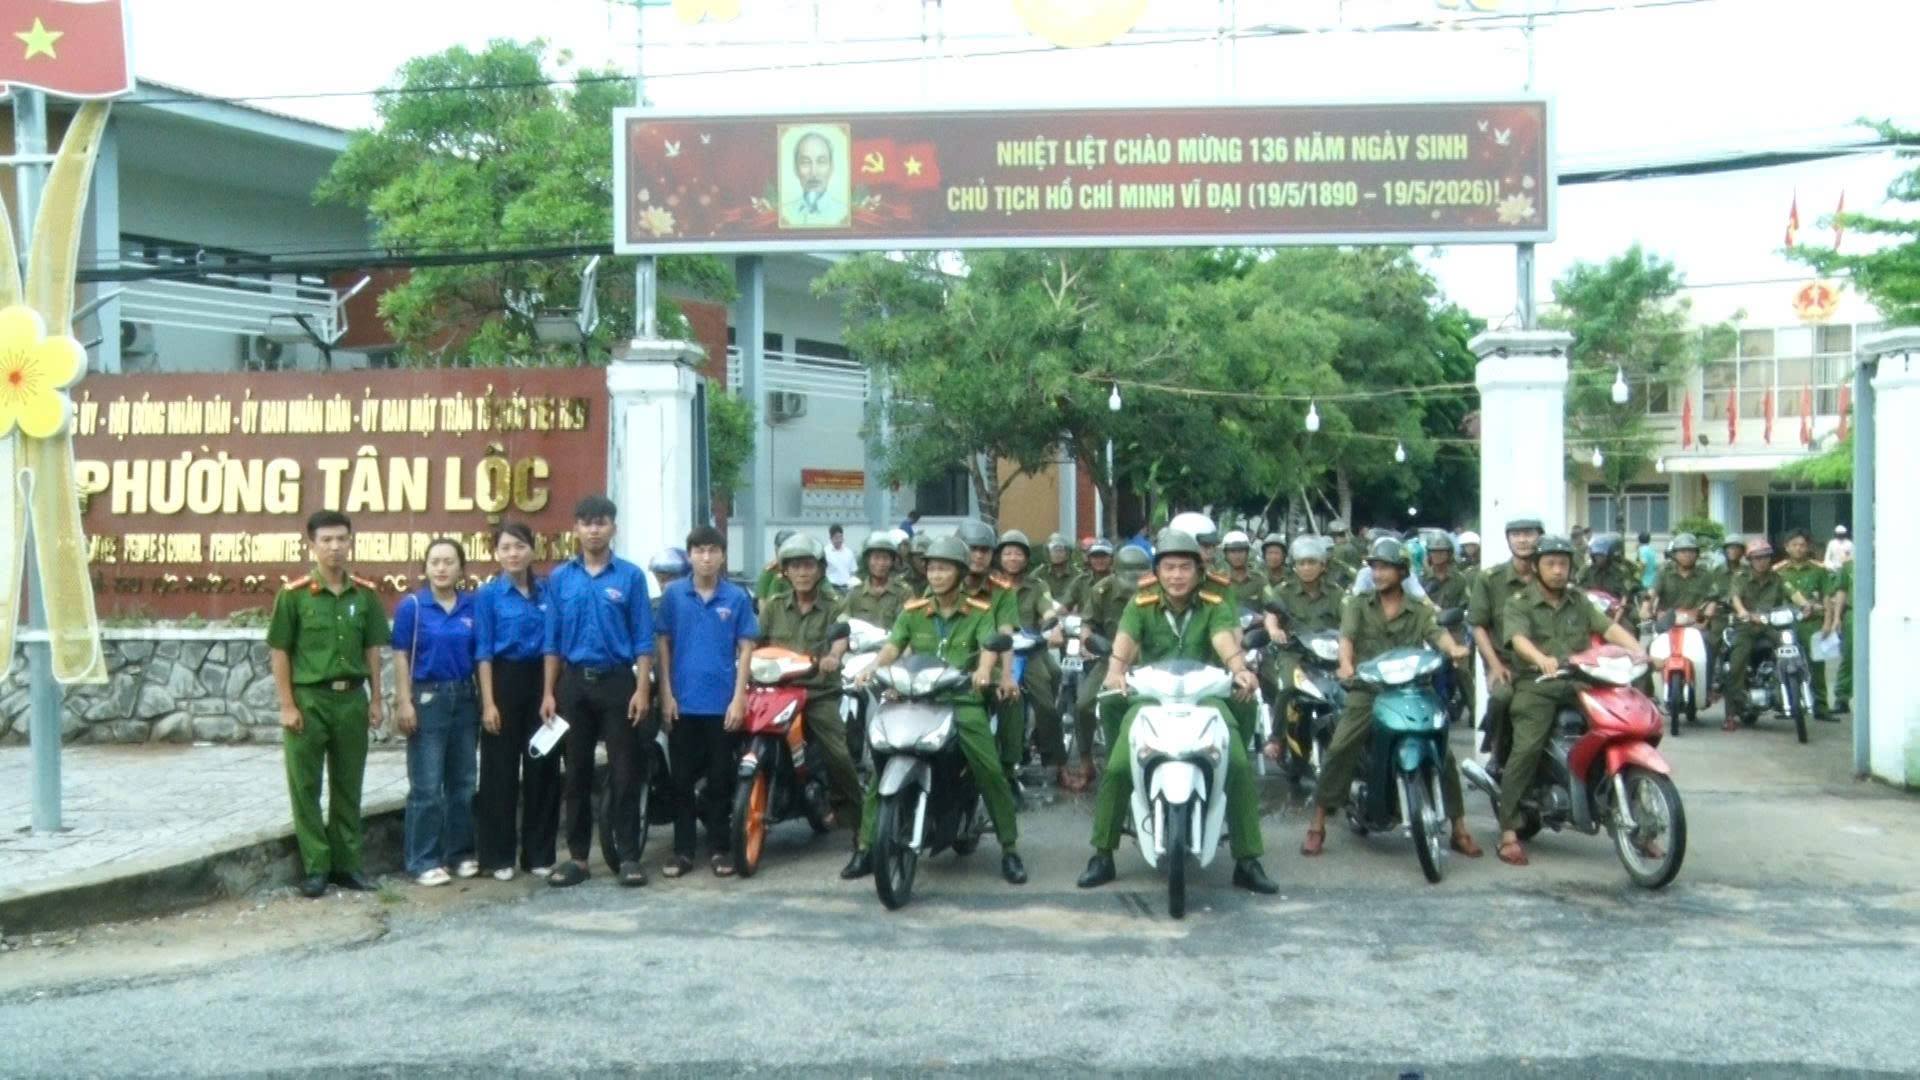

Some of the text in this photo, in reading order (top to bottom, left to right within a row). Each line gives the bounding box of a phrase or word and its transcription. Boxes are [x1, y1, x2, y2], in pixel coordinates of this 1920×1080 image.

[997, 130, 1468, 171] NHIỆT LIỆT CHÀO MỪNG 136 NĂM NGÀY SINH
[947, 177, 988, 211] CHỦ
[994, 185, 1040, 216] TỊCH
[1045, 176, 1073, 210] HỒ
[1079, 179, 1113, 209] CHÍ
[1119, 183, 1174, 209] MINH
[1181, 178, 1201, 208] VĨ
[1206, 182, 1241, 214] ĐẠI
[1247, 181, 1358, 209] (19/5/1890
[1382, 179, 1501, 208] 19/5/2026)!
[80, 389, 98, 435] ỦY
[168, 394, 202, 434] NHÂN
[205, 394, 231, 434] DÂN
[241, 388, 258, 434] ỦY
[261, 399, 287, 433] BAN
[288, 392, 323, 433] NHÂN
[325, 392, 351, 432] DÂN
[361, 386, 379, 432] ỦY
[381, 399, 408, 432] BAN
[76, 442, 550, 525] PHƯỜNG TÂN LỘC
